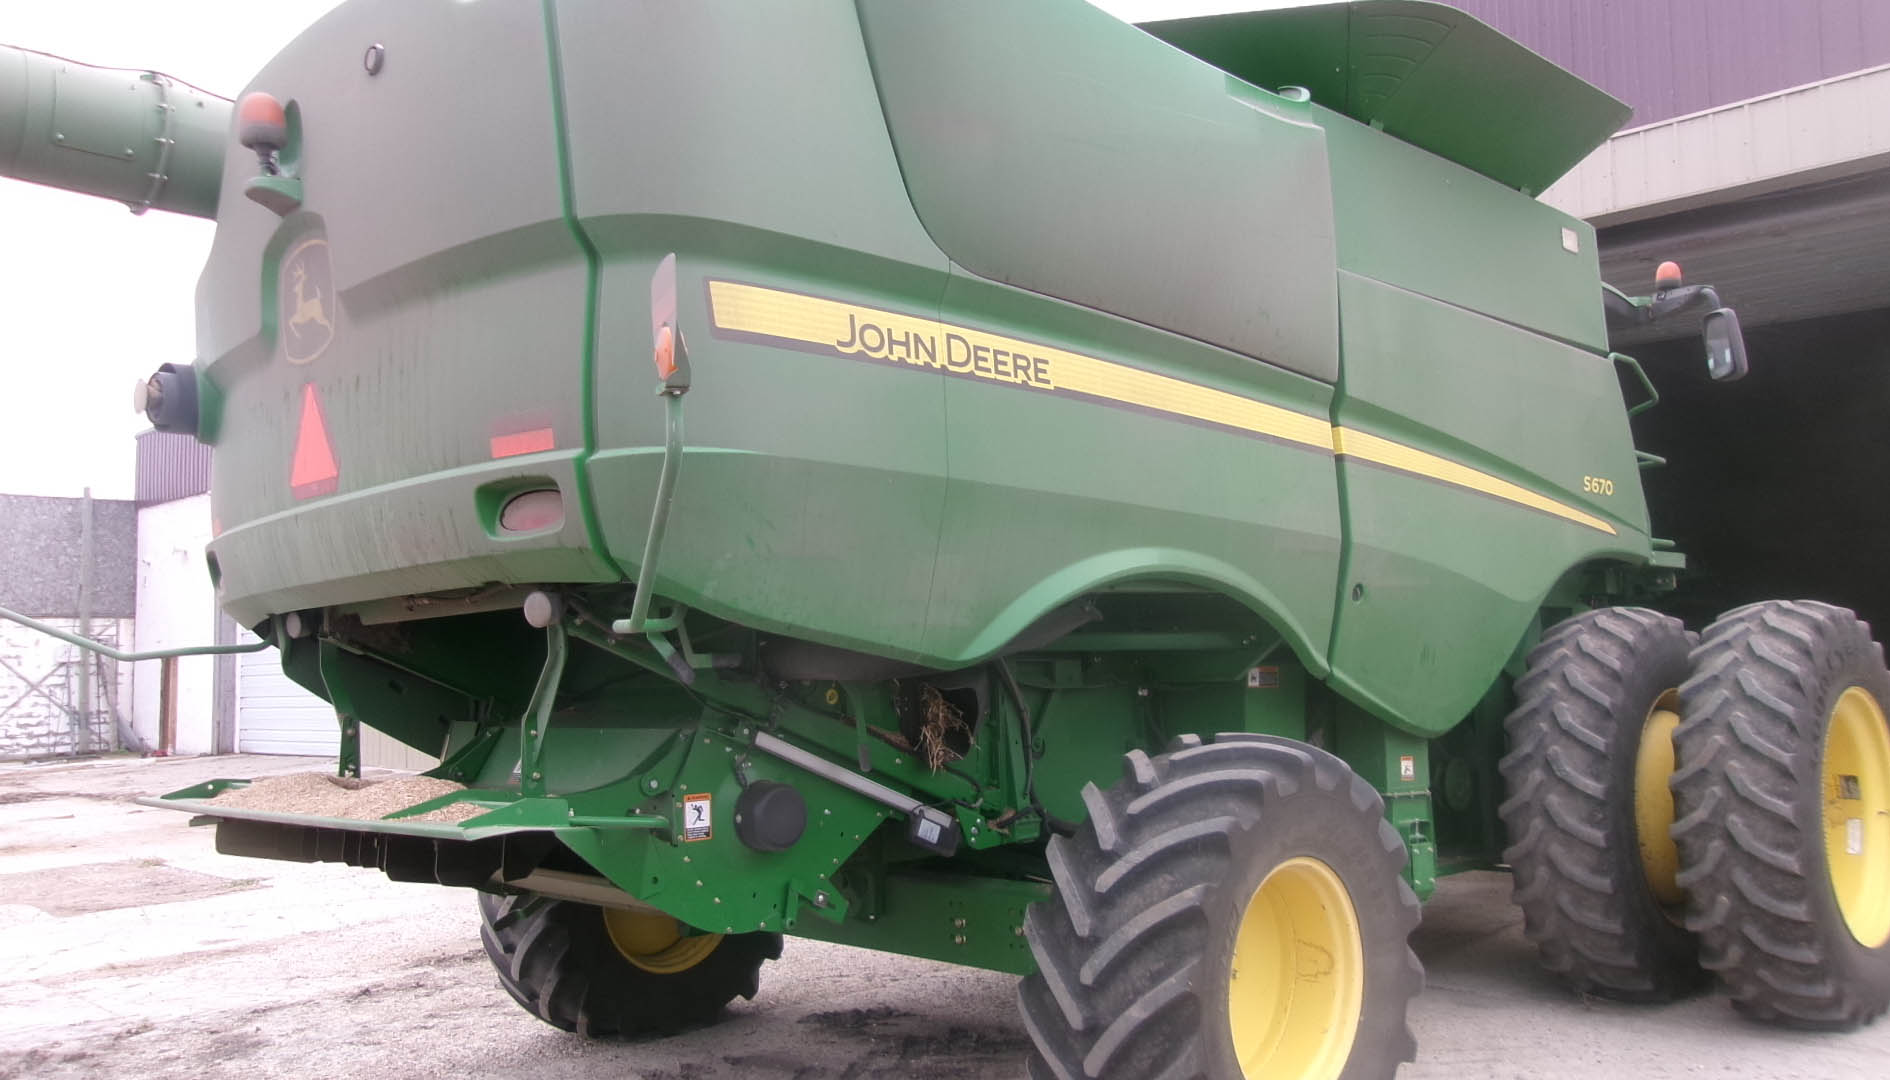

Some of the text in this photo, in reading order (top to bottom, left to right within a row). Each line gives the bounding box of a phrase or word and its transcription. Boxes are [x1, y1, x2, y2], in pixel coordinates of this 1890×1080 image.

[836, 314, 1051, 385] JOHN DEERE
[1583, 475, 1614, 496] S670
